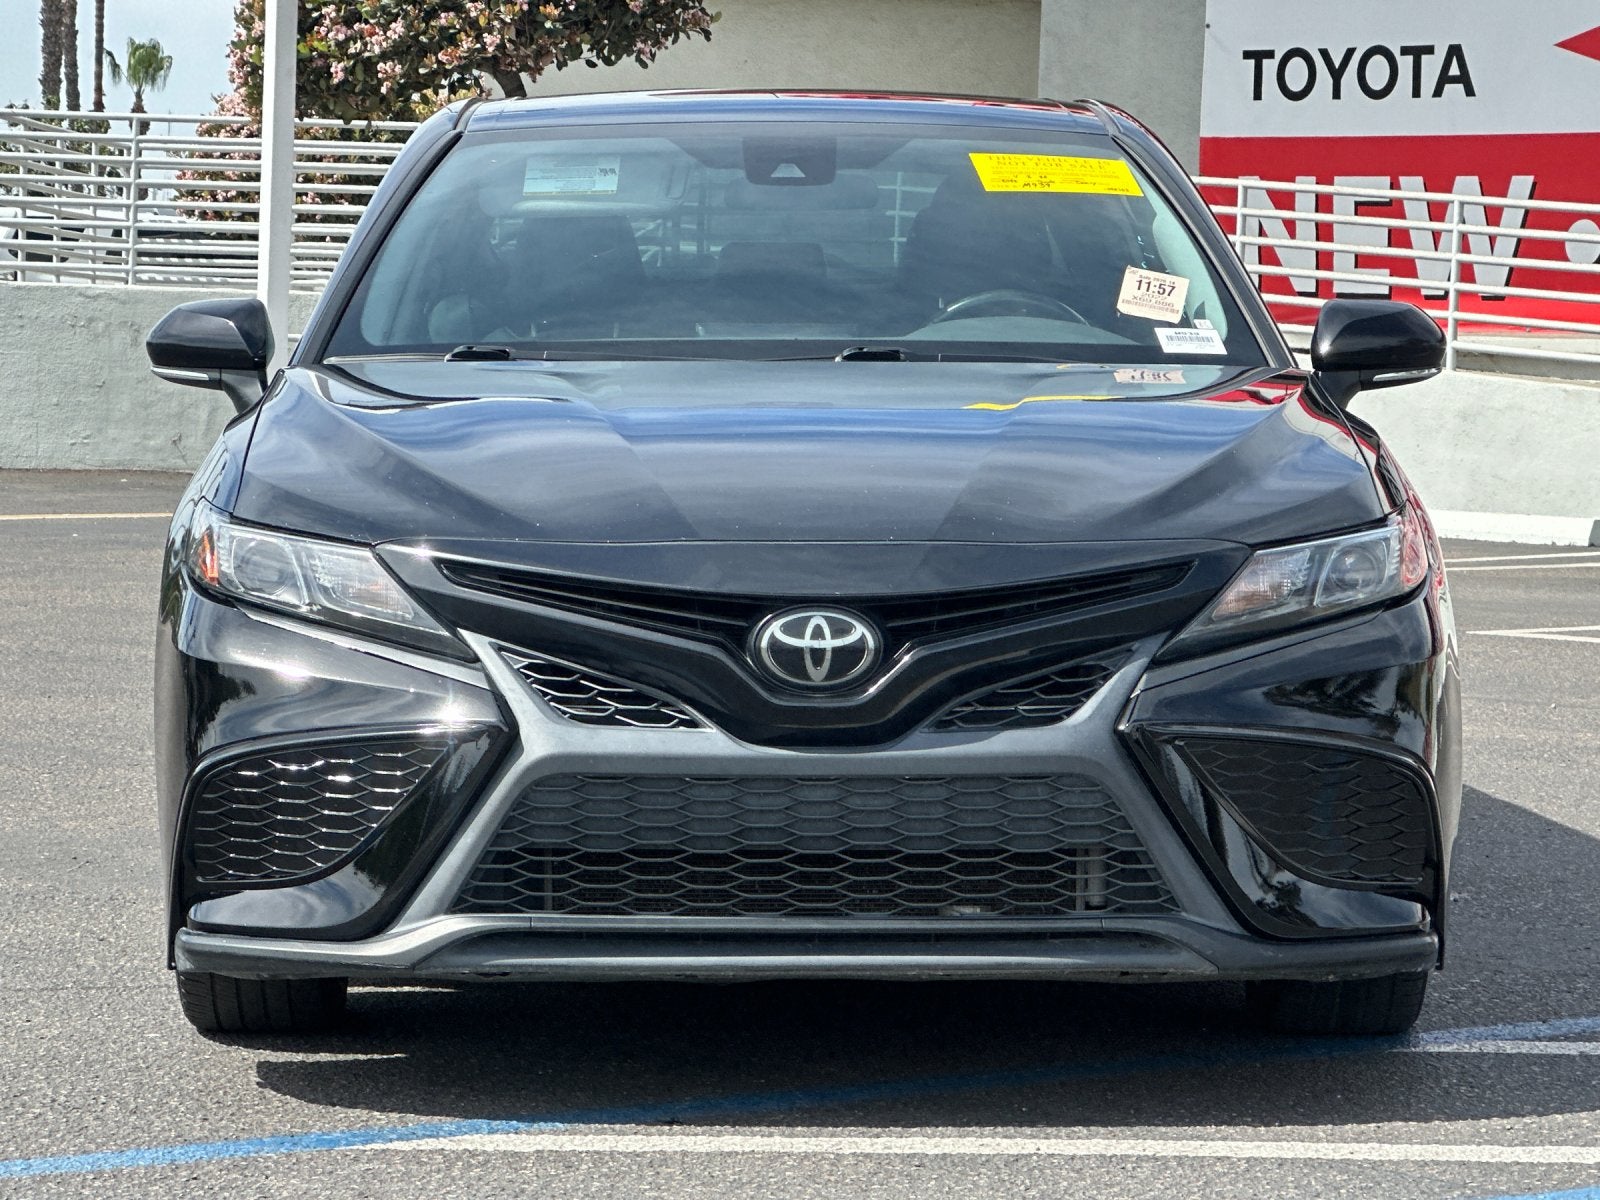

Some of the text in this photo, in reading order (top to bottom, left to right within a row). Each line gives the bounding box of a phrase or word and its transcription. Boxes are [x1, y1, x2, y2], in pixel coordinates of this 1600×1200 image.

[1242, 43, 1476, 101] TOYOTA
[1239, 175, 1536, 300] NEW
[1136, 279, 1176, 297] 11:57
